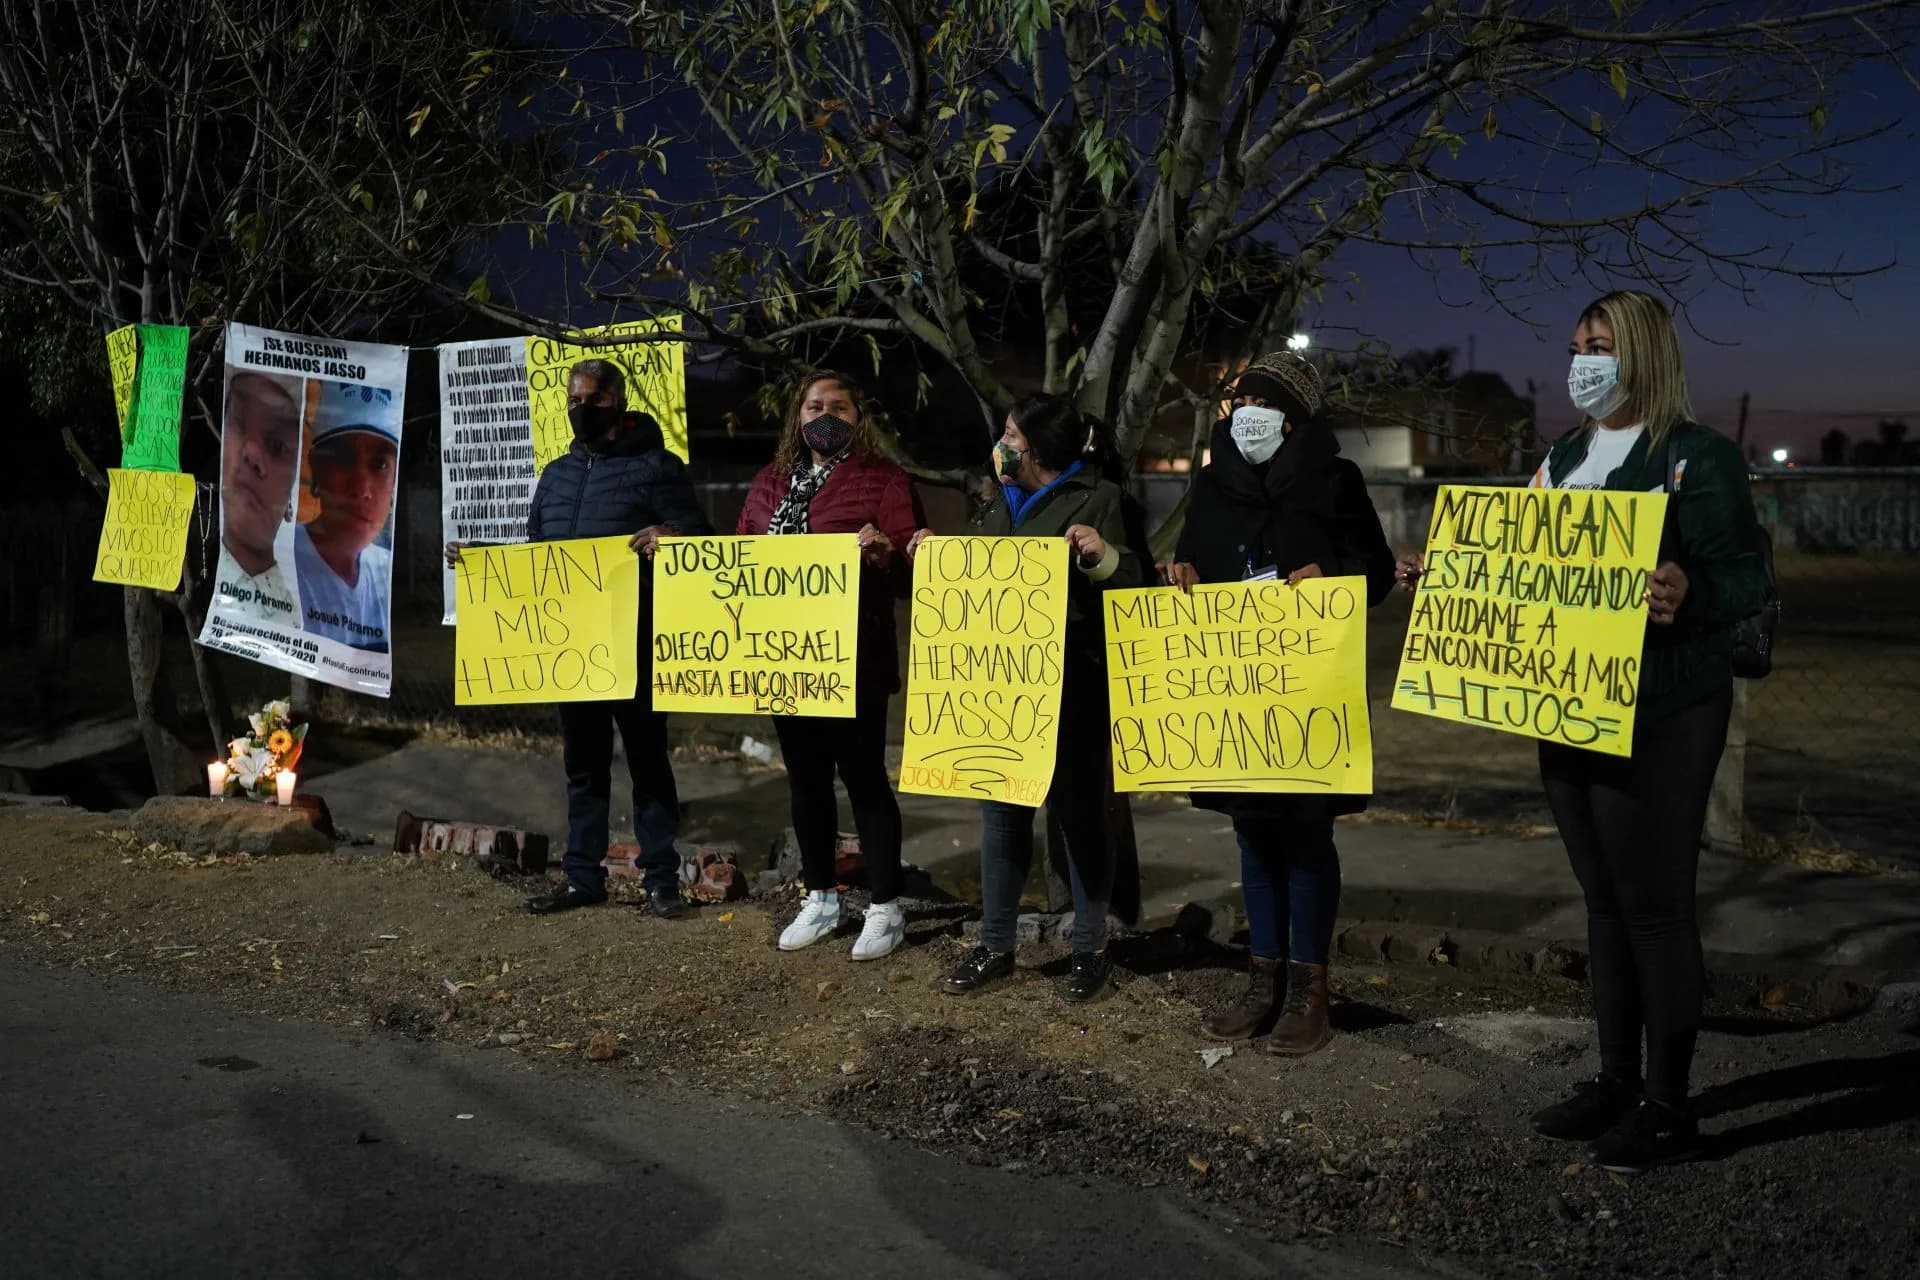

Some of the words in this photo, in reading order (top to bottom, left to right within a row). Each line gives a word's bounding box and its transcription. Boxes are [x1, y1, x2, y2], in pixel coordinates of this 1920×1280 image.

[244, 350, 320, 374] HERMANOS
[323, 361, 366, 380] JASSO
[284, 339, 348, 361] BUSCAN!
[531, 339, 575, 366] QUE
[617, 347, 673, 377] SIGAN
[110, 470, 160, 505] VIVOS
[163, 472, 184, 505] SE
[106, 502, 138, 525] LOS
[1430, 490, 1638, 560] MICHOACAN
[105, 527, 153, 555] VIVOS
[658, 540, 759, 576] JOSUE
[457, 544, 603, 605] FALTAN
[711, 563, 846, 600] SALOMON
[1420, 550, 1490, 592] ESTA
[1497, 559, 1651, 611] AGONIZANDO
[220, 581, 252, 601] Diego
[254, 588, 293, 613] Páramo
[914, 586, 1055, 640] SOMOS
[1111, 585, 1286, 633] MIENTRAS
[1296, 586, 1355, 620] NO
[212, 615, 292, 645] Desaparecidos
[292, 637, 303, 648] el
[303, 639, 319, 654] día
[307, 608, 339, 626] Josué
[341, 615, 383, 638] Páramo
[494, 598, 570, 646] MIS
[724, 601, 744, 643] Y
[1415, 593, 1528, 645] AYUDAME
[1536, 606, 1558, 646] A
[291, 648, 316, 662] 2020
[655, 629, 729, 663] DIEGO
[744, 629, 850, 663] ISRAEL
[911, 640, 1061, 687] HERMANOS
[1108, 638, 1157, 671] TE
[1165, 627, 1336, 661] ENTIERRE
[457, 643, 617, 698] HIJOS
[653, 669, 724, 697] HASTA
[1112, 673, 1163, 707] TE
[1166, 662, 1309, 700] SEGUIRE
[1405, 633, 1557, 691] ENCONTRAR
[1559, 647, 1577, 694] A
[1583, 652, 1637, 708] MIS
[754, 696, 798, 715] LOS
[1113, 703, 1351, 775] BUSCANDO!
[902, 766, 969, 793] JOSUE
[1004, 775, 1047, 802] DIEGO
